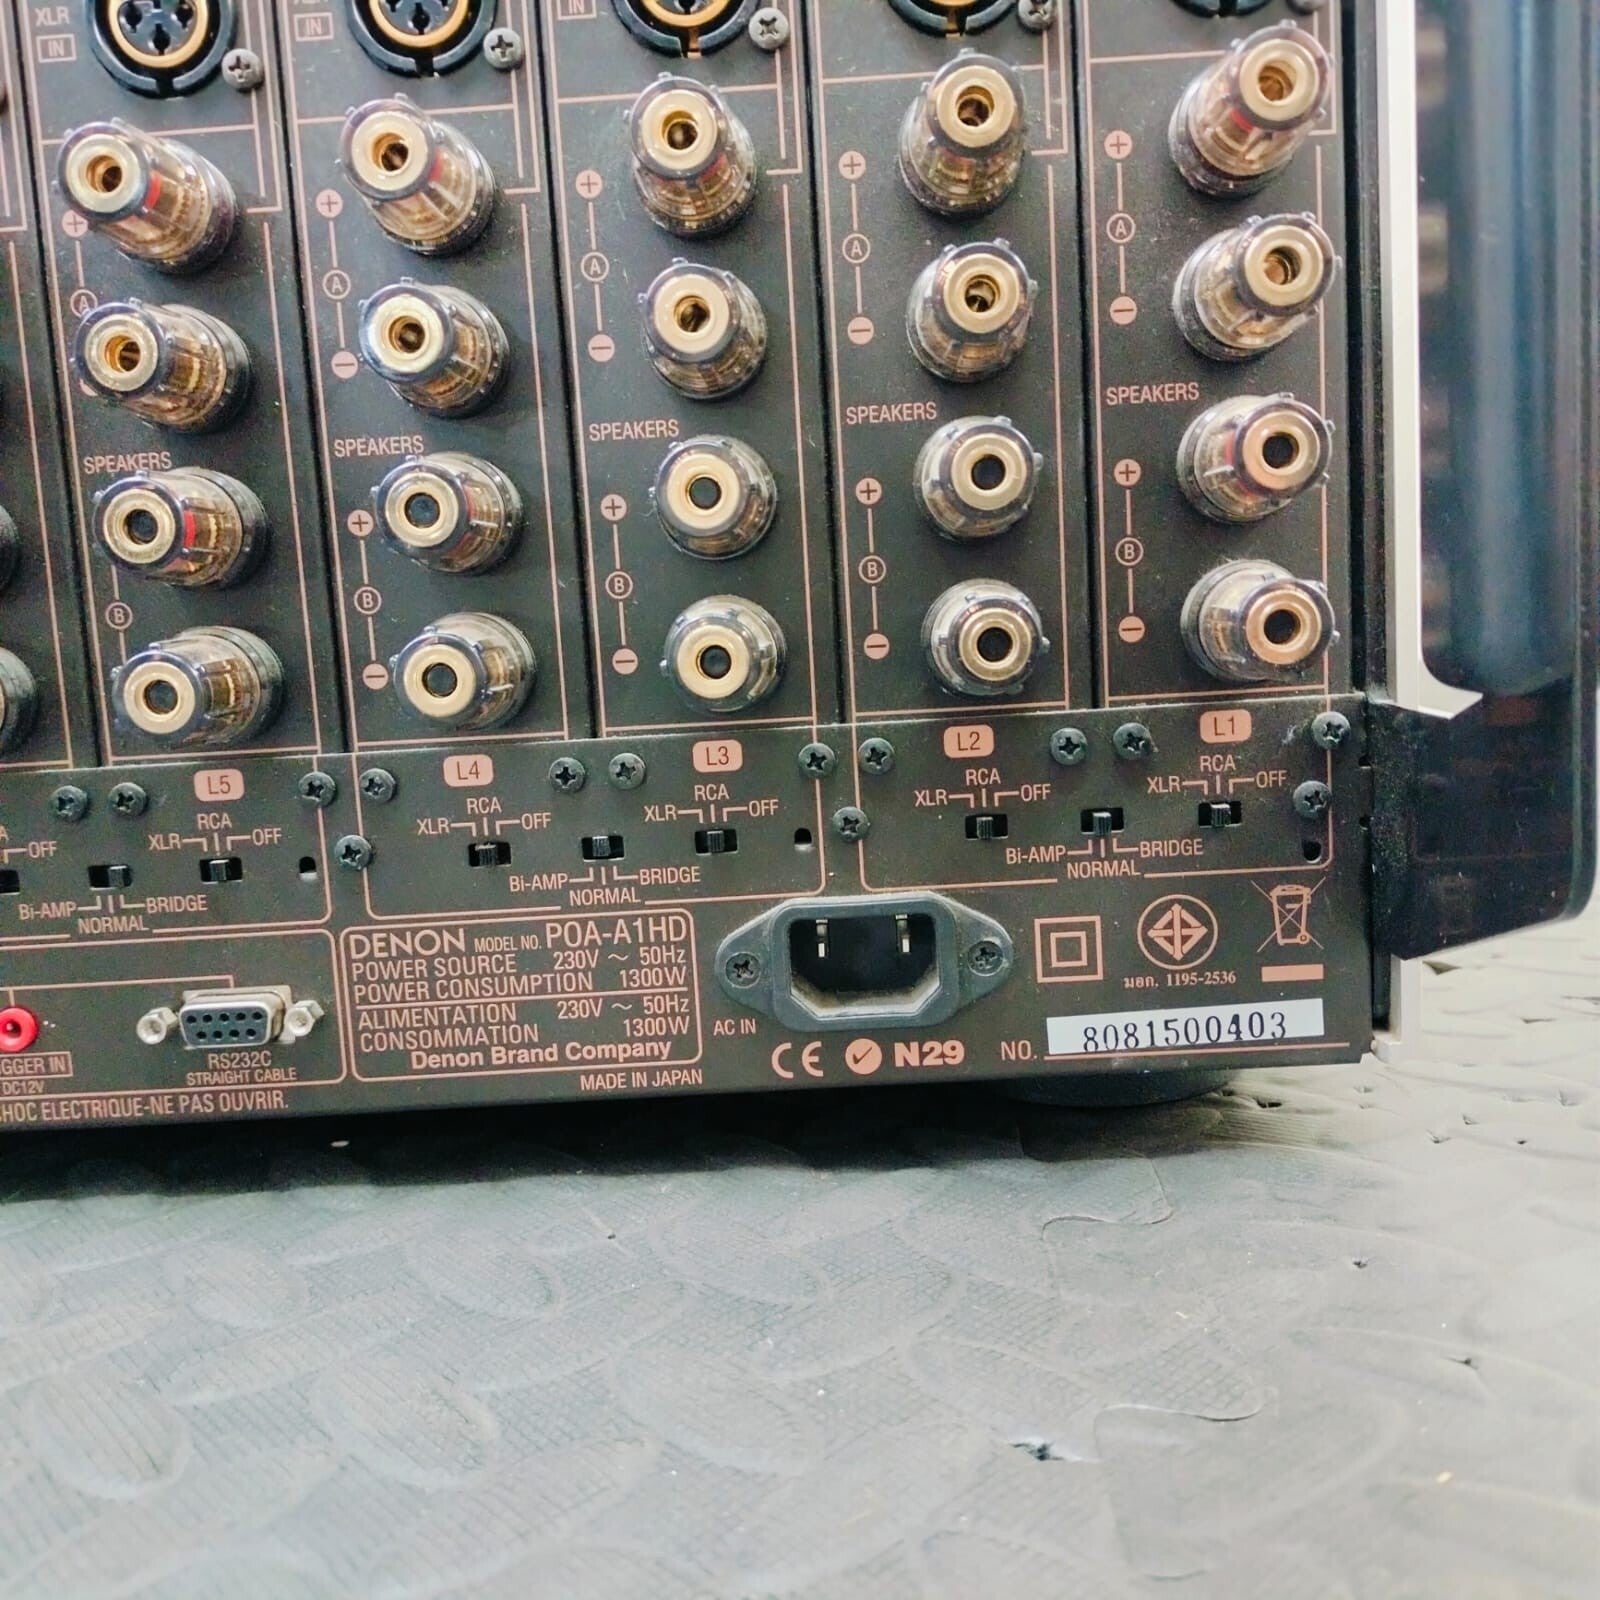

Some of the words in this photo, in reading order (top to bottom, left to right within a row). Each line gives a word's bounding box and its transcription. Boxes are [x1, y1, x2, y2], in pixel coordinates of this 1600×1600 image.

[35, 7, 69, 27] XLR
[305, 18, 322, 35] IN
[48, 39, 65, 57] IN
[1106, 382, 1201, 406] SPEAKERS
[846, 401, 938, 425] SPEAKERS
[588, 419, 680, 442] SPEAKERS
[334, 436, 425, 458] SPEAKERS
[84, 451, 172, 475] SPEAKERS
[1213, 719, 1237, 737] L1
[957, 732, 981, 752] L2
[706, 747, 730, 766] L3
[1200, 754, 1236, 772] RCA
[457, 762, 481, 780] L4
[966, 768, 1001, 786] RCA
[208, 775, 231, 795] L5
[694, 783, 730, 802] RCA
[1147, 776, 1181, 794] XLR
[1256, 771, 1287, 788] OFF
[467, 797, 502, 815] RCA
[914, 790, 947, 807] XLR
[1020, 784, 1051, 801] OFF
[197, 813, 232, 830] RCA
[644, 805, 677, 823] XLR
[748, 800, 779, 817] OFF
[417, 818, 450, 836] XLR
[521, 812, 552, 829] OFF
[28, 841, 57, 858] OFF
[149, 834, 182, 851] XLR
[252, 828, 282, 845] OFF
[1005, 845, 1066, 864] Bi-AMP
[1139, 838, 1204, 858] BRIDGE
[509, 873, 568, 893] Bi-AMP
[639, 866, 701, 886] BRIDGE
[1067, 860, 1141, 879] NORMAL
[19, 900, 77, 920] Bi-AMP
[147, 894, 207, 914] BRIDGE
[569, 887, 641, 906] NORMAL
[78, 915, 149, 935] NORMAL
[350, 928, 465, 960] DENON
[474, 936, 518, 953] MODEL
[521, 935, 542, 951] NO.
[545, 916, 687, 949] POA-A1HD
[352, 957, 428, 982] POWER
[434, 953, 517, 976] SOURCE
[553, 949, 599, 970] 230V
[639, 945, 686, 965] 50Hz
[354, 979, 430, 1004] POWER
[436, 971, 593, 998] CONSUMPTION
[619, 967, 687, 989] 1300W
[1166, 971, 1237, 987] 1195-2536
[358, 1002, 517, 1031] ALIMENTATION
[557, 999, 602, 1020] 230V
[643, 995, 689, 1015] 50Hz
[360, 1024, 539, 1052] CONSOMMATION
[623, 1016, 689, 1037] 1300W
[713, 1019, 736, 1036] AC
[741, 1018, 756, 1034] IN
[1083, 1011, 1287, 1053] 8081500403
[208, 1051, 272, 1069] RS232C
[411, 1049, 484, 1070] Denon
[491, 1043, 558, 1066] Brand
[565, 1040, 672, 1061] Company
[894, 1039, 965, 1067] N29
[1000, 1040, 1037, 1061] NO.
[0, 1057, 46, 1076] GGER
[49, 1055, 66, 1073] IN
[2, 1080, 45, 1095] DC12V
[186, 1069, 251, 1087] STRAIGHT
[255, 1067, 297, 1083] CABLE
[580, 1072, 627, 1091] MADE
[631, 1071, 648, 1088] IN
[652, 1069, 703, 1087] JAPAN
[0, 1101, 38, 1122] HOC
[182, 1094, 214, 1114] PAS
[219, 1090, 289, 1112] OUVRIR.
